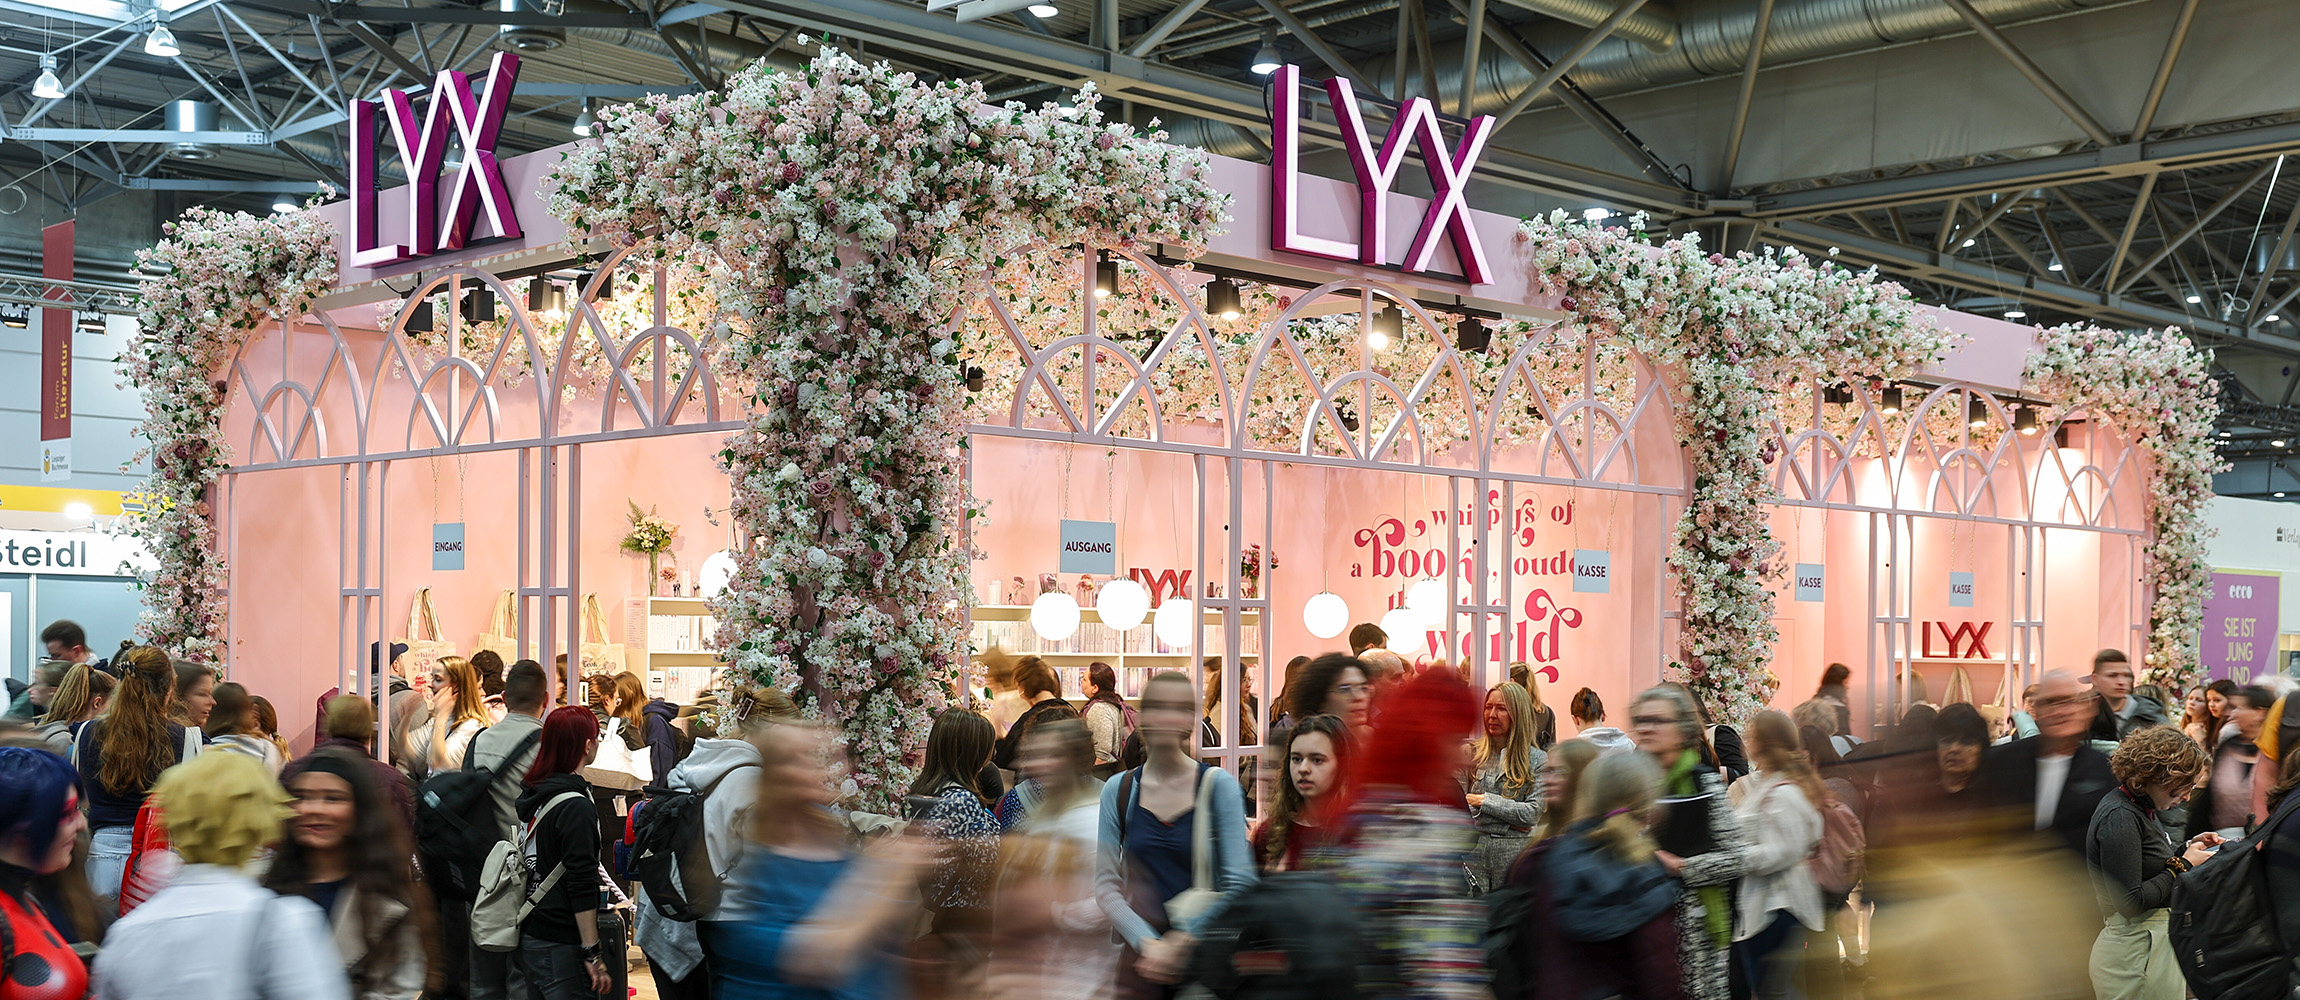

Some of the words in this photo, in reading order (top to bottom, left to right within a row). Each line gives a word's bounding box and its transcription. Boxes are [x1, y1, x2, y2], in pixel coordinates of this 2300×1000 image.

[349, 50, 524, 268] LYX
[1271, 63, 1498, 286] LYX
[60, 340, 68, 419] Literatur
[1551, 499, 1575, 526] of
[0, 538, 86, 567] teidl
[435, 541, 462, 552] EINGANG
[1065, 541, 1112, 553] AUSGANG
[1350, 562, 1362, 578] a
[1578, 564, 1606, 578] KASSE
[1798, 577, 1822, 588] KASSE
[1952, 583, 1972, 595] KASSE
[2229, 584, 2253, 599] ecco
[2223, 616, 2240, 637] SIE
[2241, 617, 2257, 638] IST
[1922, 621, 1994, 659] LYX
[2225, 641, 2254, 662] JUNG
